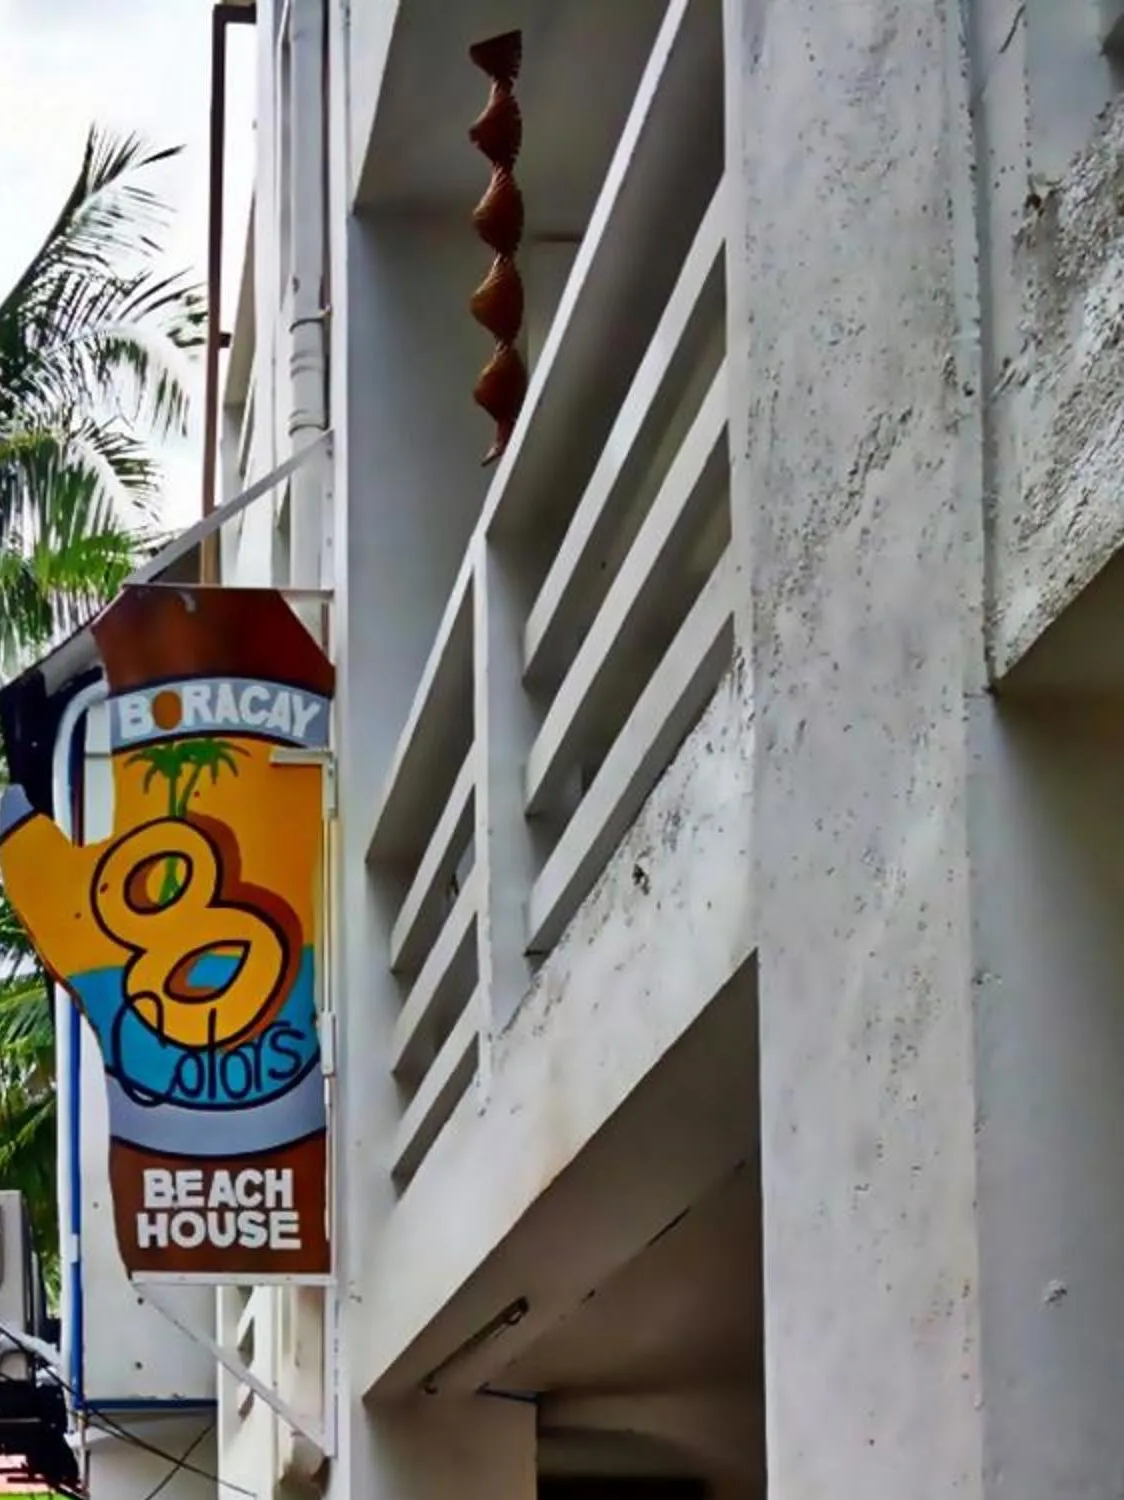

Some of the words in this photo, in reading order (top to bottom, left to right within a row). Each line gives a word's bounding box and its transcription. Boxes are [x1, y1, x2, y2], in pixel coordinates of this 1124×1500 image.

[118, 683, 321, 739] BORACAY
[90, 816, 291, 1052] 8
[112, 991, 306, 1107] Colors
[143, 1168, 293, 1209] BEACH
[136, 1210, 301, 1249] HOUSE
